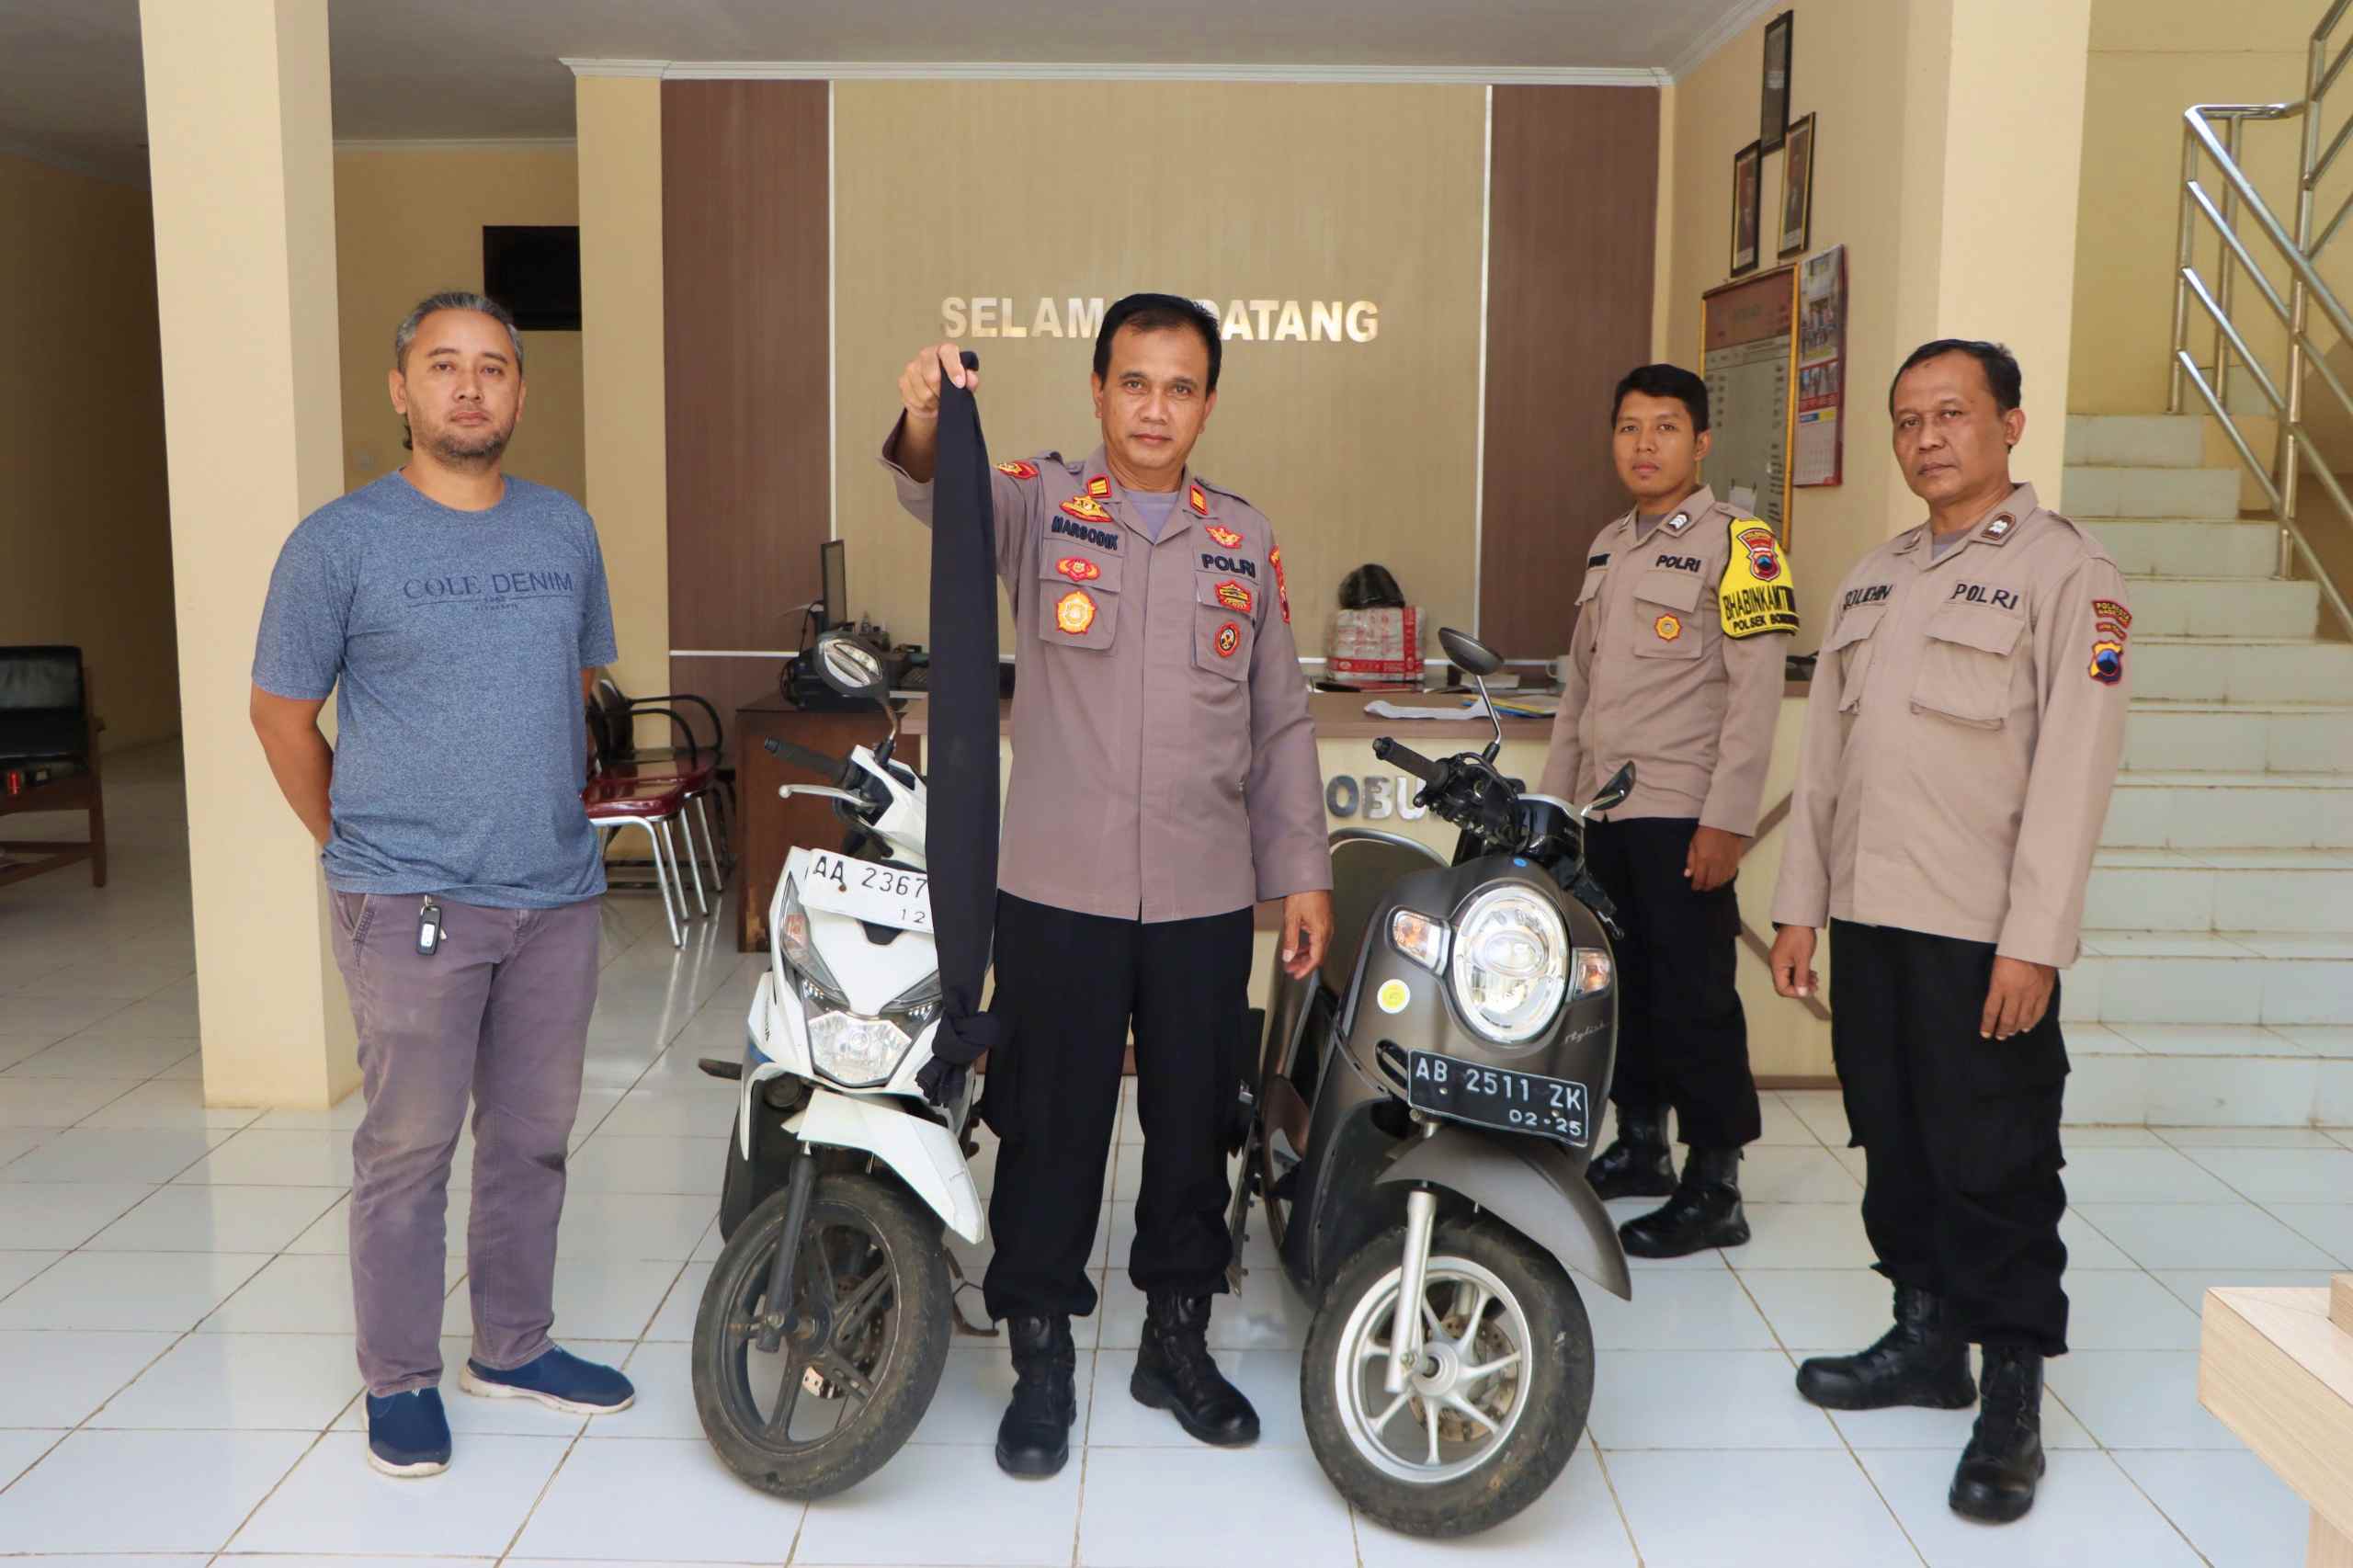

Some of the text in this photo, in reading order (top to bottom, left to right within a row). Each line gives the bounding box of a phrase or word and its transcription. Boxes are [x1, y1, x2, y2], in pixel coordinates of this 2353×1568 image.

[940, 296, 1108, 339] SELAM
[1201, 553, 1256, 579] POLRI
[1655, 554, 1700, 574] POLRI
[403, 573, 574, 598] COLE DENIM
[1949, 584, 2019, 609] POLRI
[1733, 615, 1766, 632] POLSEK
[813, 856, 927, 898] AA 2367
[1415, 1057, 1581, 1111] AB 2511 ZK
